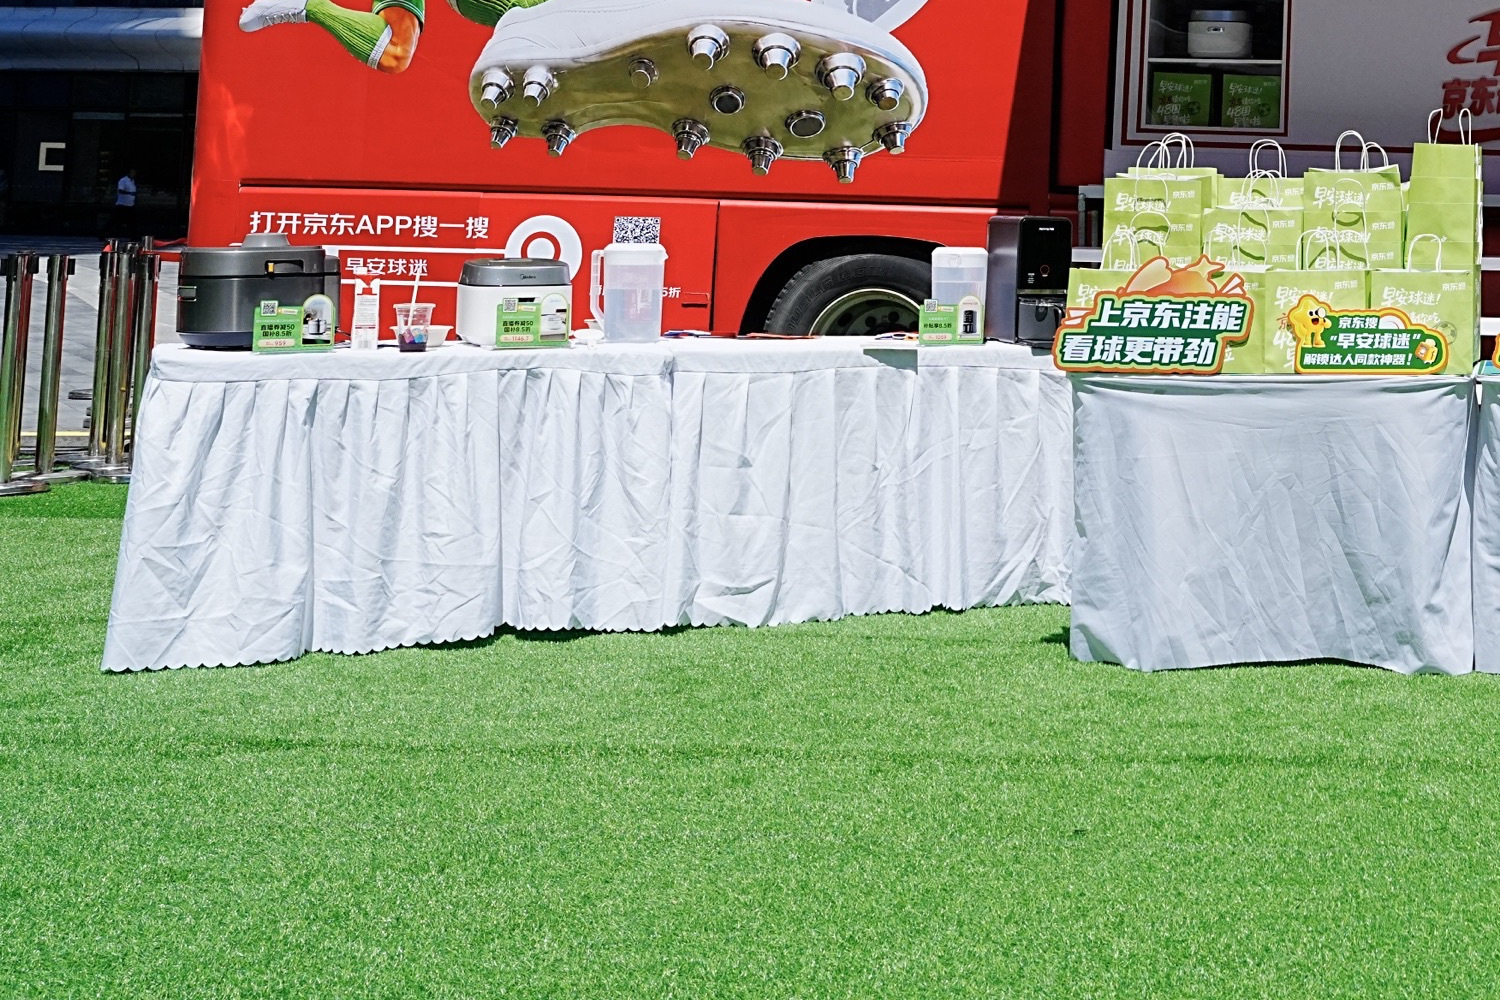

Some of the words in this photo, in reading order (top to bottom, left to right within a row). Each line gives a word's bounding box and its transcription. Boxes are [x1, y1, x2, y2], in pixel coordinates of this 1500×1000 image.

[249, 210, 489, 239] 打开京东APP搜一搜
[345, 257, 428, 277] 早安球迷
[1381, 286, 1442, 307] 早安球迷!
[1090, 299, 1246, 331] 上京东注能
[1338, 316, 1380, 329] 京东搜
[1062, 334, 1217, 365] 看球更带劲
[1303, 353, 1413, 366] 解锁达人同款神器!
